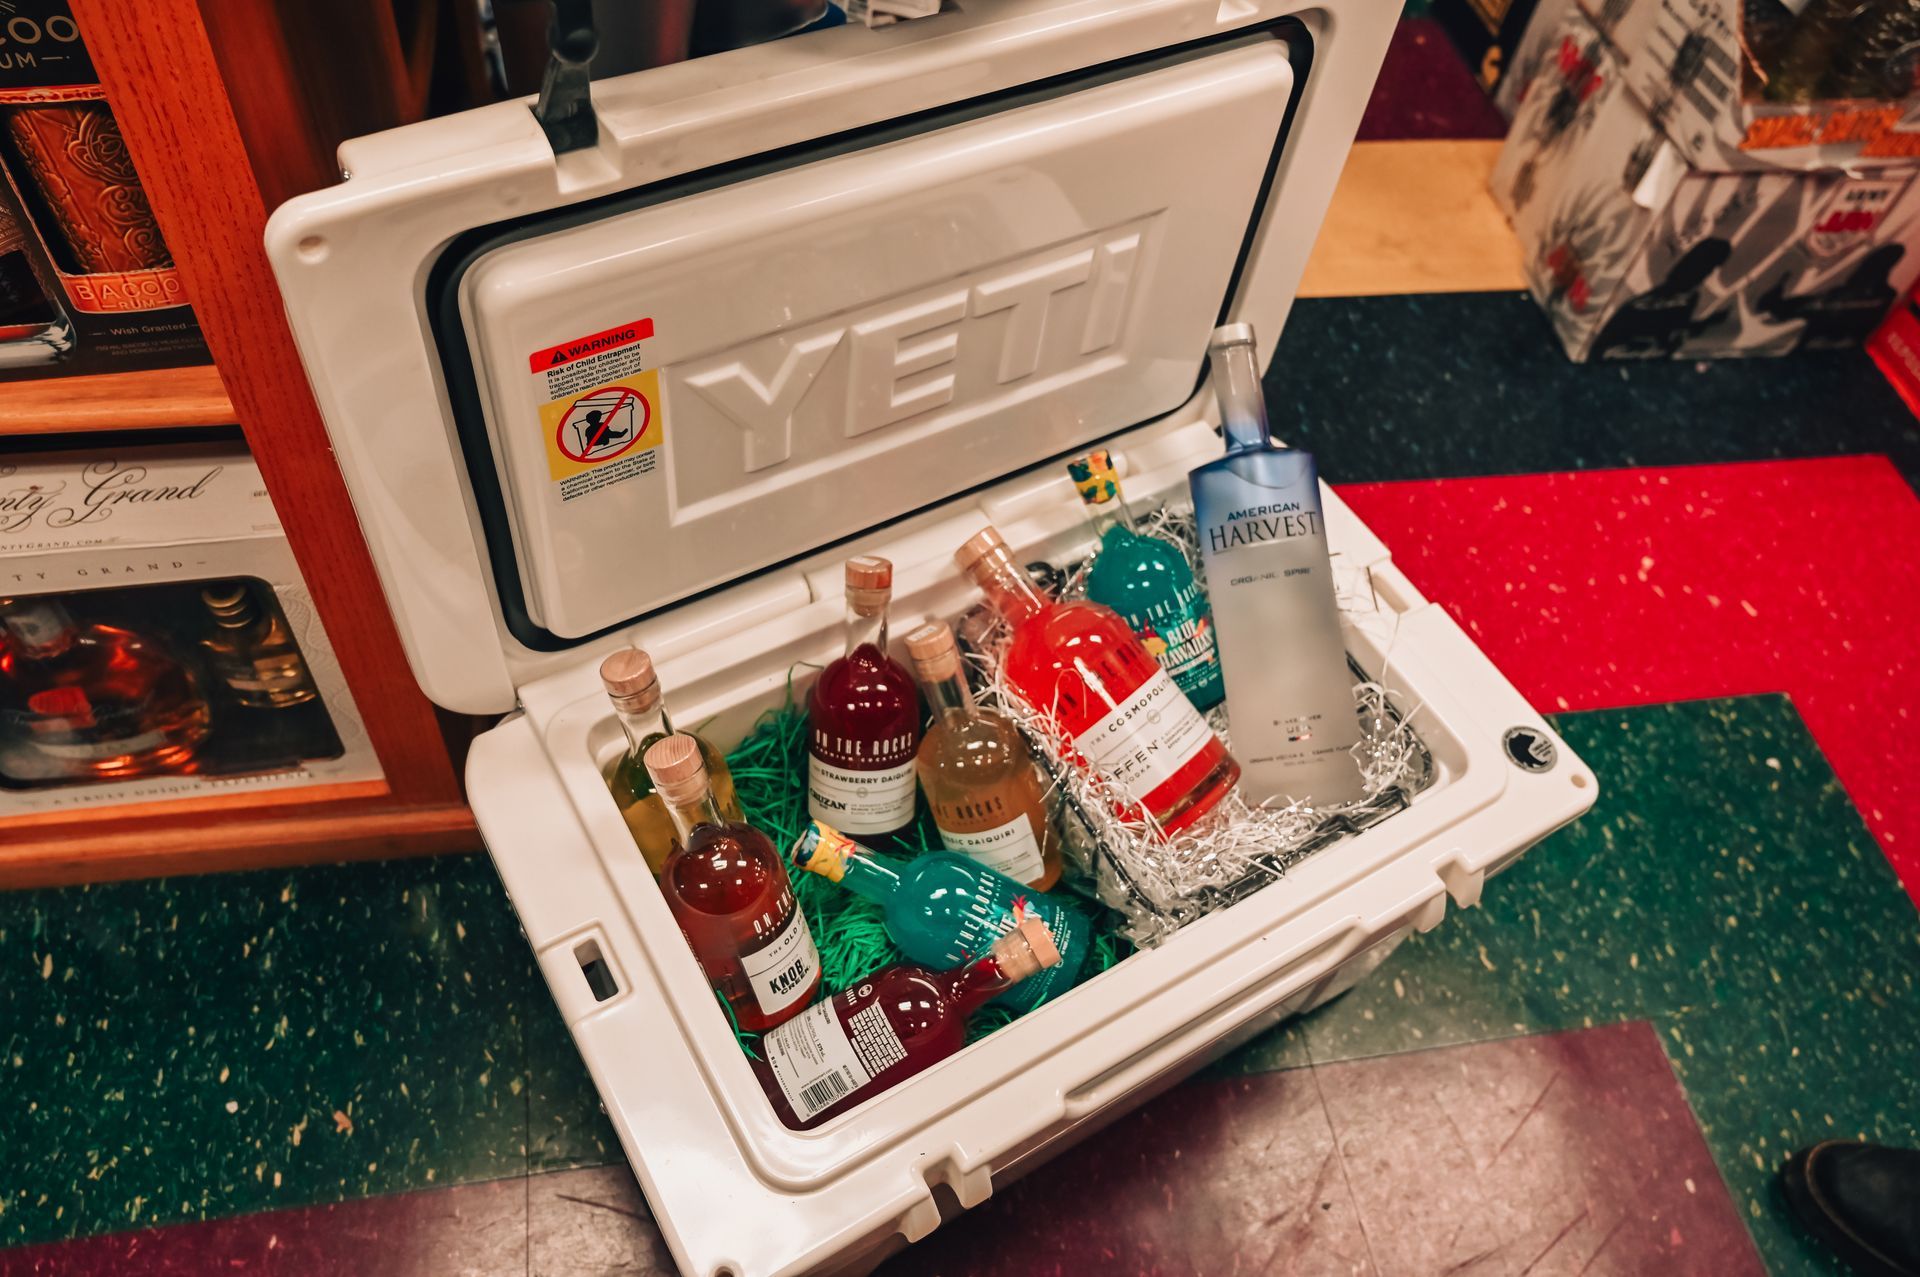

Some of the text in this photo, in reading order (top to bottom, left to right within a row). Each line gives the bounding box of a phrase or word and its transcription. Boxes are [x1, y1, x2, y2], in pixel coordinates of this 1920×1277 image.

[0, 15, 80, 46] OO
[75, 278, 180, 300] BACOO
[119, 300, 156, 310] RUM
[110, 323, 187, 336] Wish Granted
[568, 329, 636, 358] WARNING
[547, 344, 640, 378] Risk of Child Entrapment
[682, 232, 1141, 474] YETI
[549, 379, 573, 389] trapped
[575, 372, 594, 381] inside
[608, 361, 627, 370] cooler
[629, 356, 640, 364] and
[550, 383, 581, 395] suffocate.
[583, 376, 600, 384] Keep
[601, 369, 621, 378] cooler
[562, 369, 587, 380] possible
[599, 358, 622, 368] children
[551, 389, 578, 400] children's
[579, 383, 596, 391] reach
[597, 377, 613, 385] when
[567, 477, 593, 489] chemical
[594, 470, 613, 479] known
[633, 458, 648, 466] State
[604, 461, 623, 471] product
[636, 450, 654, 459] contain
[46, 459, 224, 528] Grand
[562, 485, 589, 496] California
[597, 476, 614, 484] cause
[563, 492, 583, 502] defects
[591, 484, 605, 492] other
[606, 472, 640, 485] reproductive
[1227, 502, 1300, 522] AMERICAN
[1209, 511, 1318, 552] HARVEST
[77, 561, 183, 578] GRAND
[1166, 618, 1197, 648] BLUE
[1108, 678, 1171, 734] COSMOPOLIT
[816, 729, 912, 756] ON THE ROCKS
[821, 769, 879, 784] STRAWBERRY
[810, 788, 847, 812] CRUZAN
[967, 828, 1016, 846] DAIQUIRI
[753, 912, 772, 934] ON
[775, 884, 792, 914] THE
[954, 920, 980, 950] THE
[971, 871, 996, 916] ROCKS
[784, 926, 799, 946] OLD
[769, 958, 805, 995] KNOB
[780, 966, 811, 996] CREEK
